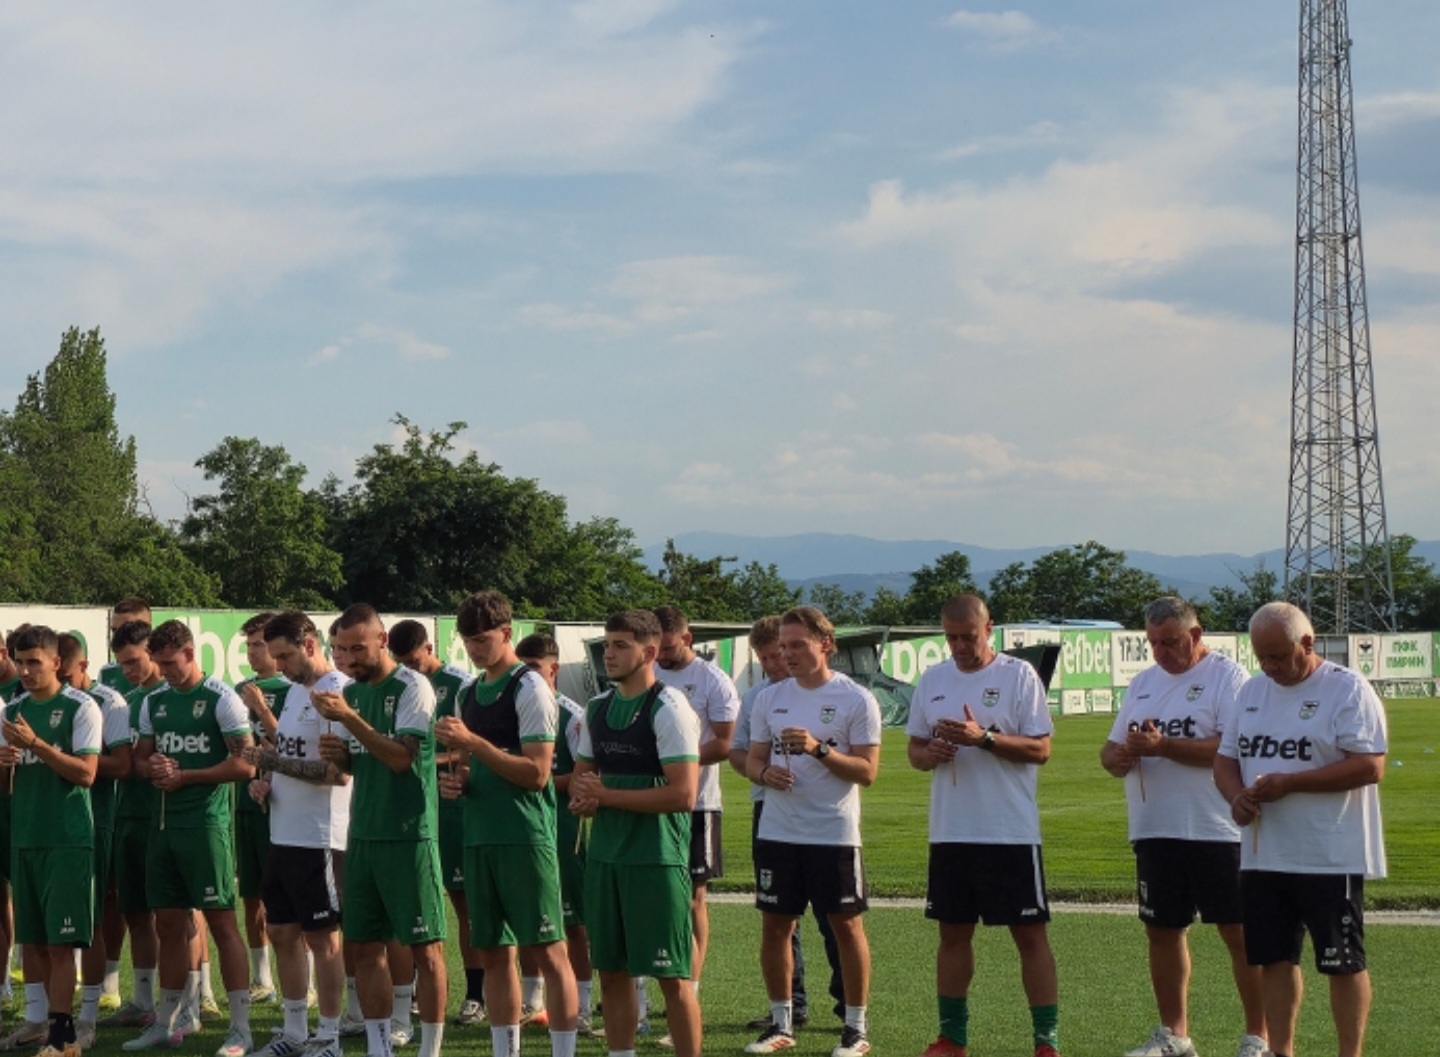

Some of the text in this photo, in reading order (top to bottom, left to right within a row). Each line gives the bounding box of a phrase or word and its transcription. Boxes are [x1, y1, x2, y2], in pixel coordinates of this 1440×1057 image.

[1063, 633, 1111, 675] efbet
[155, 730, 210, 753] efbet
[1238, 734, 1312, 762] efbet
